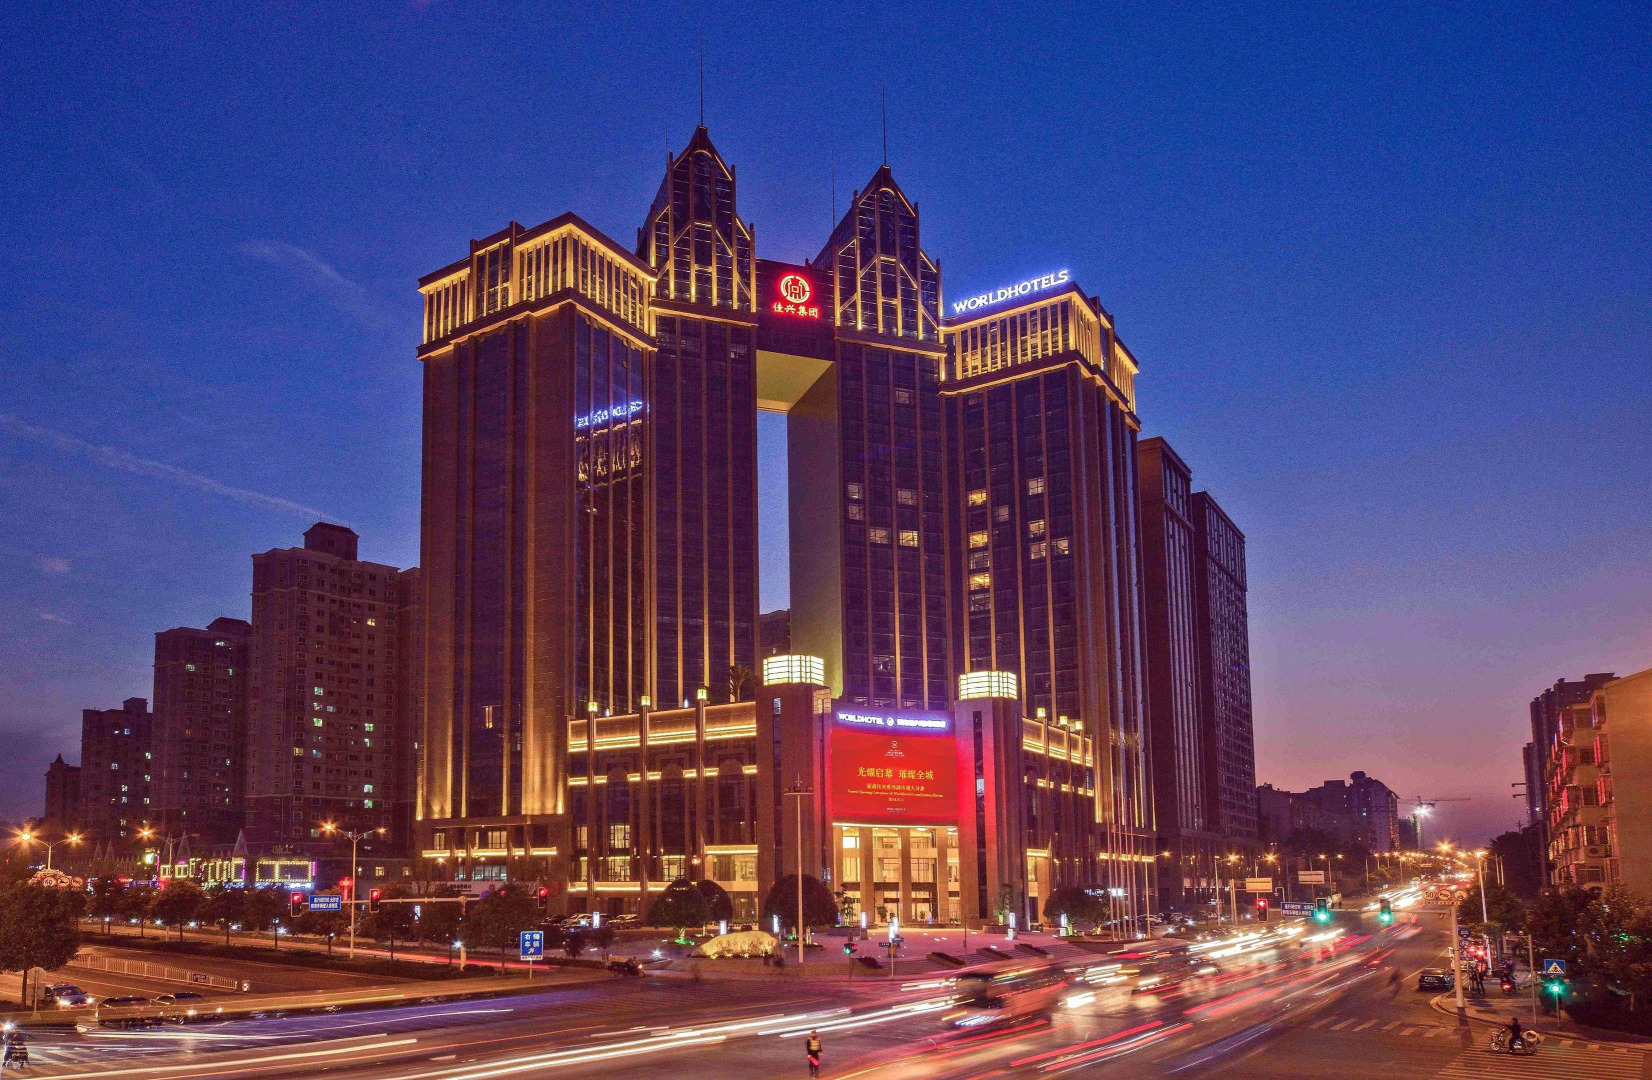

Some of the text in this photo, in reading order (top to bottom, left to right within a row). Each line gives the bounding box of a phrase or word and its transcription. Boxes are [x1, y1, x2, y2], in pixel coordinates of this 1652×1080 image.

[953, 270, 1069, 313] WORLDHOTELS
[773, 302, 818, 318] 佳兴集团
